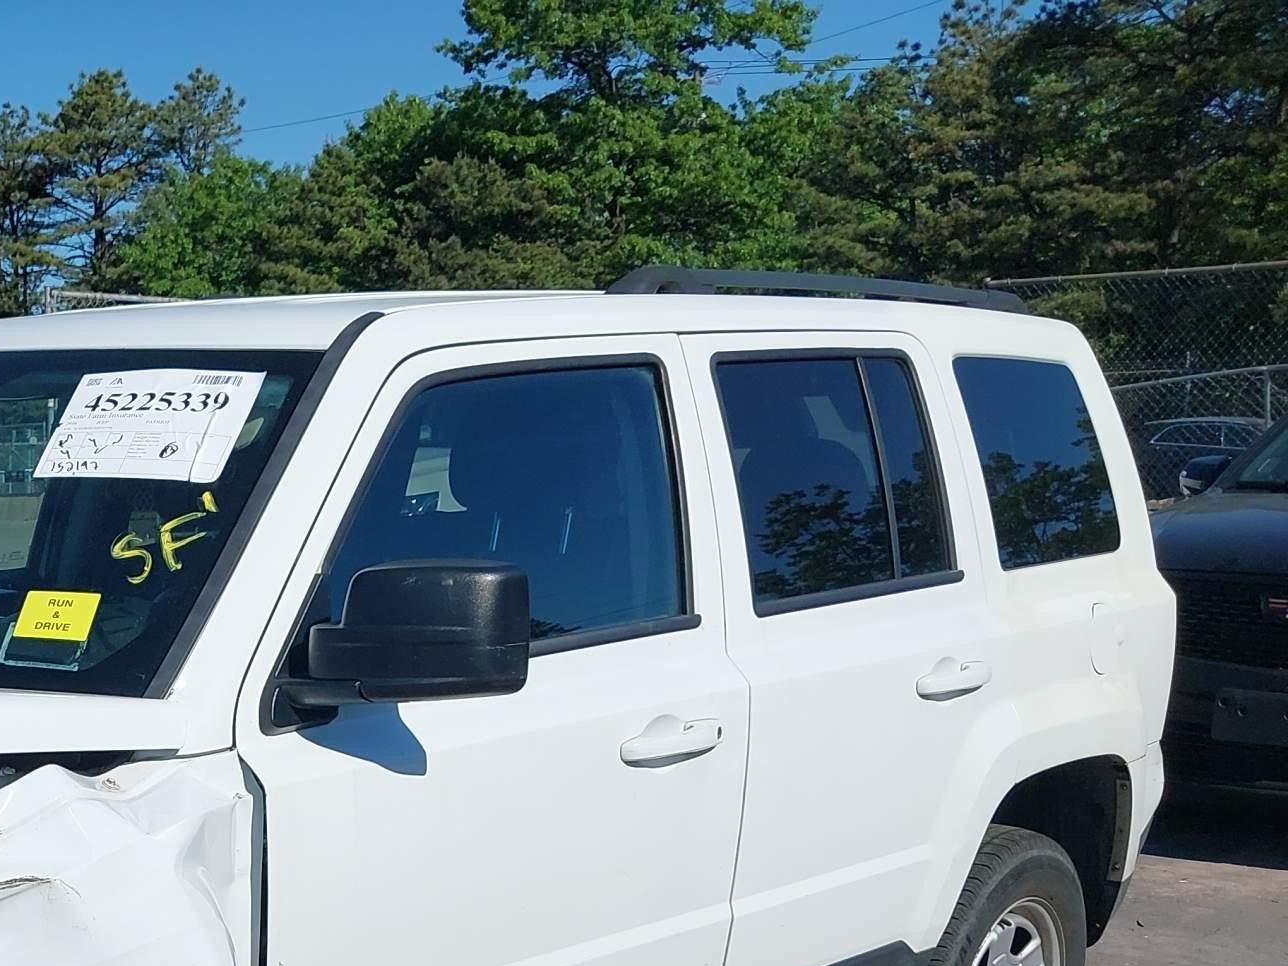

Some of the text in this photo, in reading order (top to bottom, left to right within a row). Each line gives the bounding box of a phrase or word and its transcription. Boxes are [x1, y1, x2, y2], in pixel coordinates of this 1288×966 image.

[84, 391, 230, 413] 45225339
[48, 598, 74, 607] RUN
[34, 621, 71, 632] DRIVE
